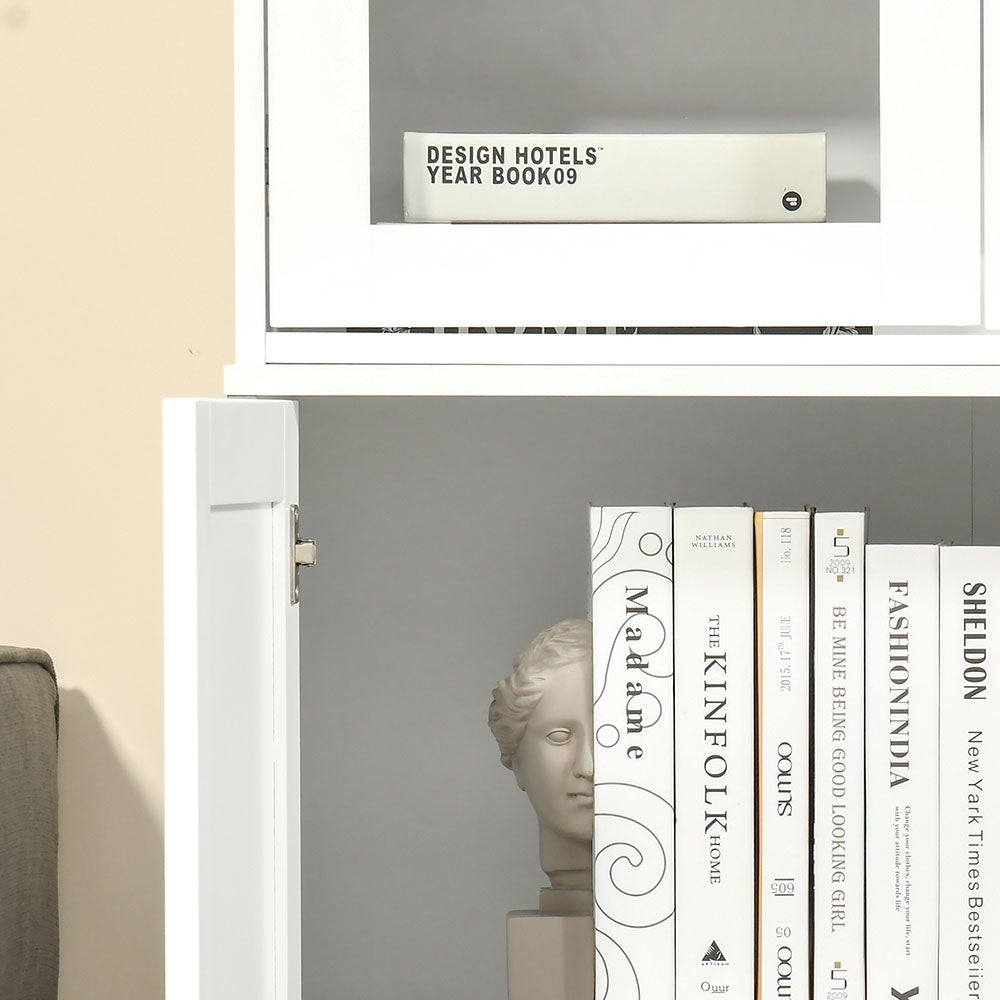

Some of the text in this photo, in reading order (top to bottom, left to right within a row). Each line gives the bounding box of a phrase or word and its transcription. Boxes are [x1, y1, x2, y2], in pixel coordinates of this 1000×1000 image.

[427, 146, 505, 165] DESIGN
[427, 166, 578, 186] YEAR BOOK09
[829, 559, 851, 567] 2009
[963, 582, 987, 700] SHELDON
[624, 585, 649, 760] Madame
[888, 580, 910, 790] FASHIONINDIA
[704, 614, 728, 885] THE KINFOLK HOME
[967, 730, 984, 774] New
[831, 606, 847, 933] BE MINE BEING GOOD LOOKING GIRL
[892, 823, 900, 840] your
[903, 806, 912, 833] Change
[894, 840, 902, 870] attitude
[902, 834, 910, 850] your
[967, 829, 984, 891] Times
[894, 870, 902, 899] towards
[903, 880, 912, 906] change
[903, 906, 911, 923] your
[826, 991, 849, 999] 2009
